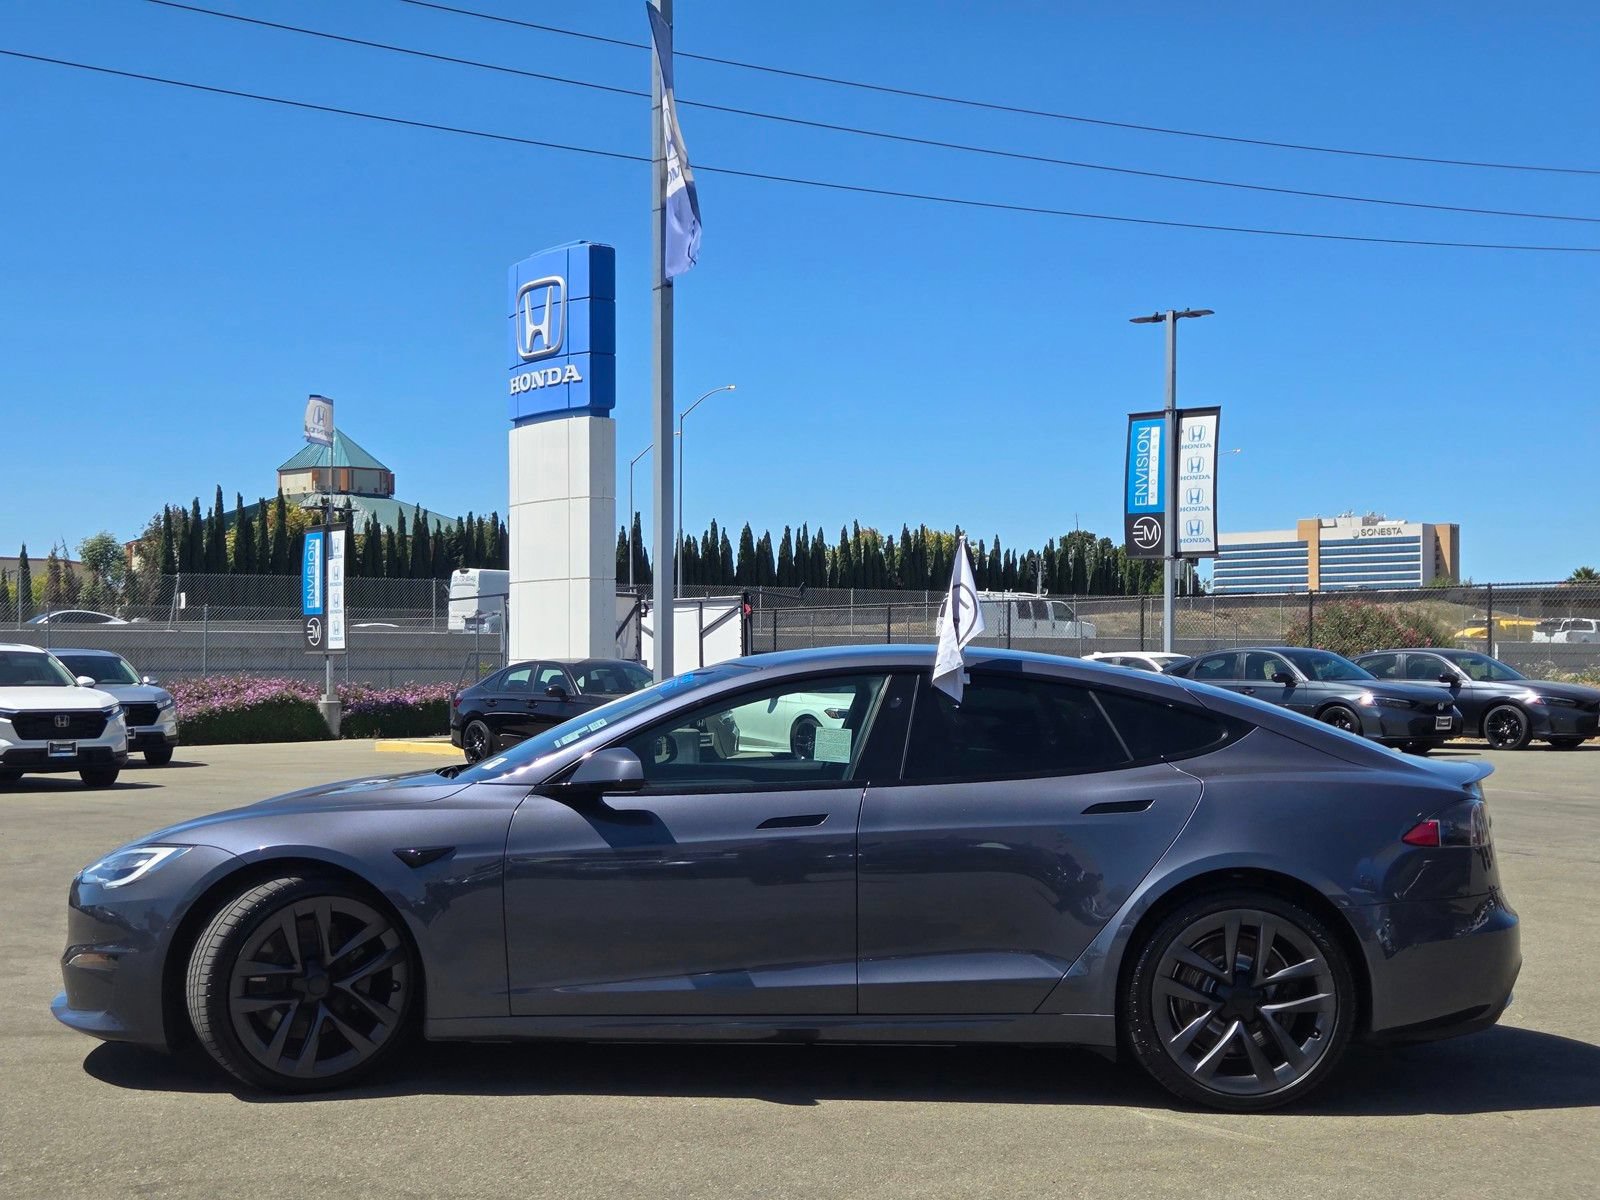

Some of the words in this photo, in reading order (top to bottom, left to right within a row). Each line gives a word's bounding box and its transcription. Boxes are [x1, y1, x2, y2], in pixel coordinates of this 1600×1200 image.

[509, 364, 583, 396] HONDA
[1181, 442, 1212, 450] HONDA
[1135, 427, 1151, 506] ENVISION
[1360, 527, 1403, 537] SONESTA
[306, 539, 316, 609] ENVISION
